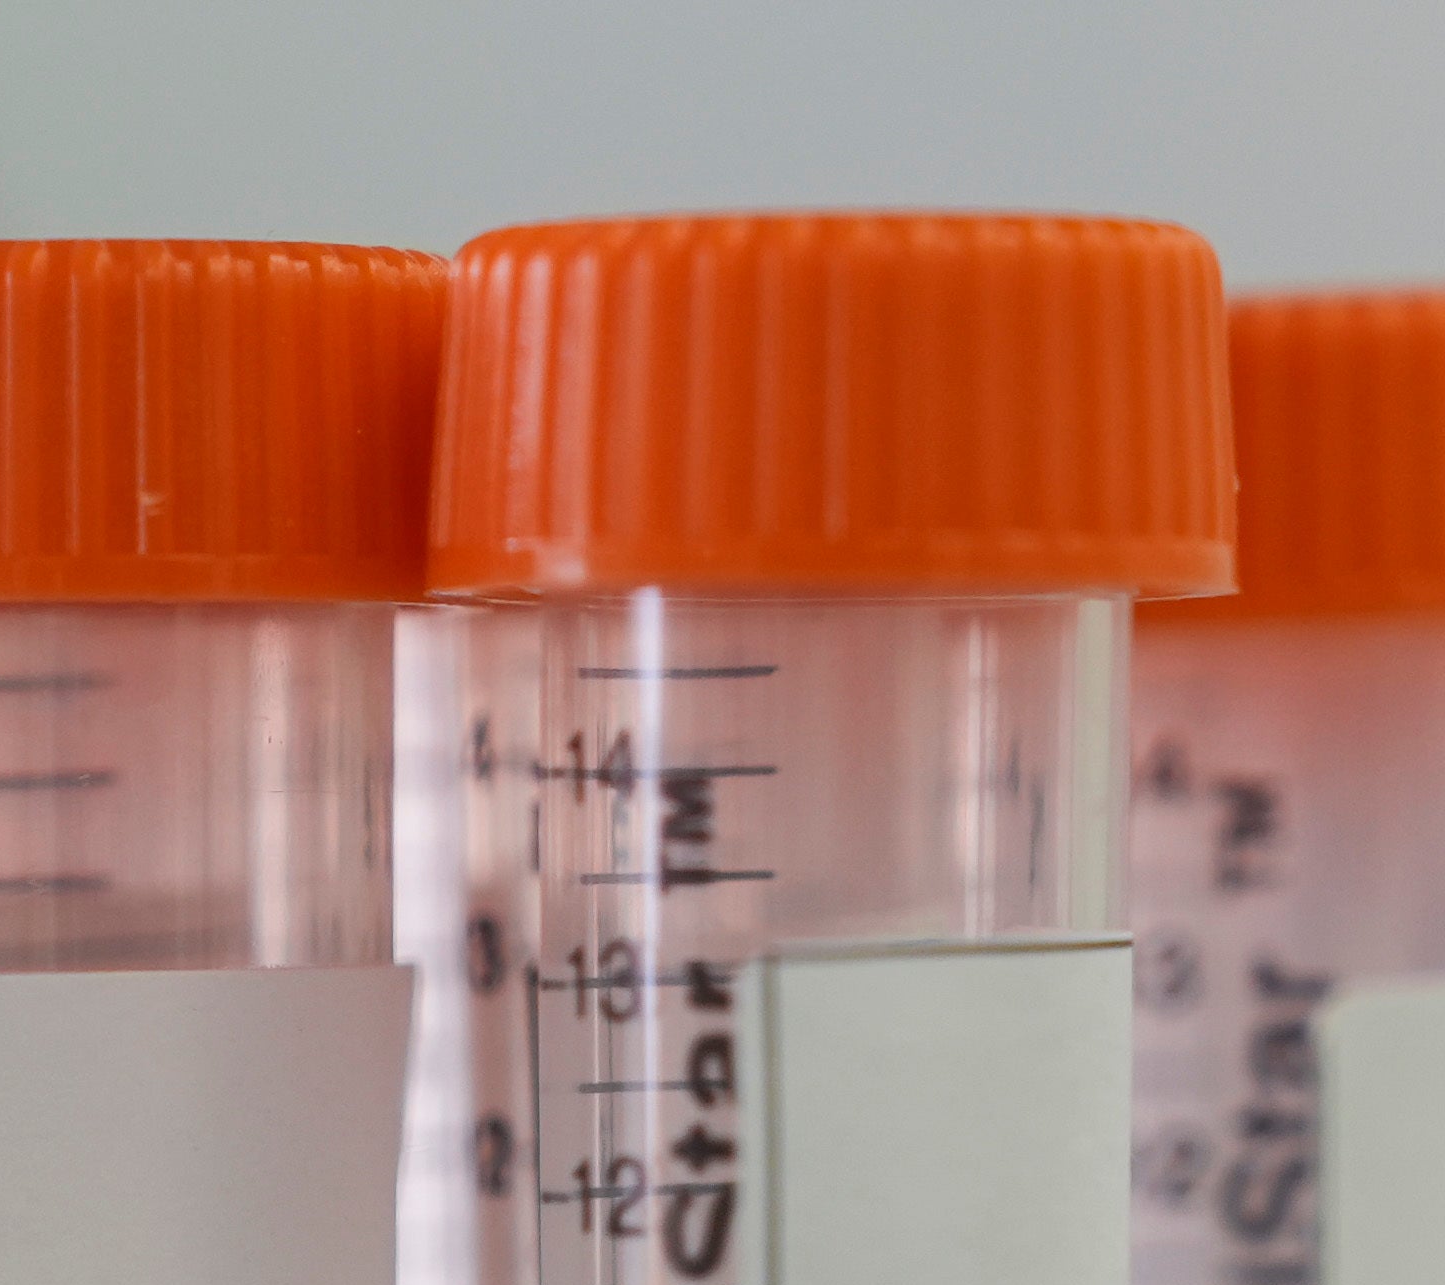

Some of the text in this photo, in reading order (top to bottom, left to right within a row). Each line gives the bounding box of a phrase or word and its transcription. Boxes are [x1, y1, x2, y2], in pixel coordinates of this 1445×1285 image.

[568, 729, 635, 804] 14
[570, 939, 644, 1024] 13
[572, 1157, 645, 1237] 12
